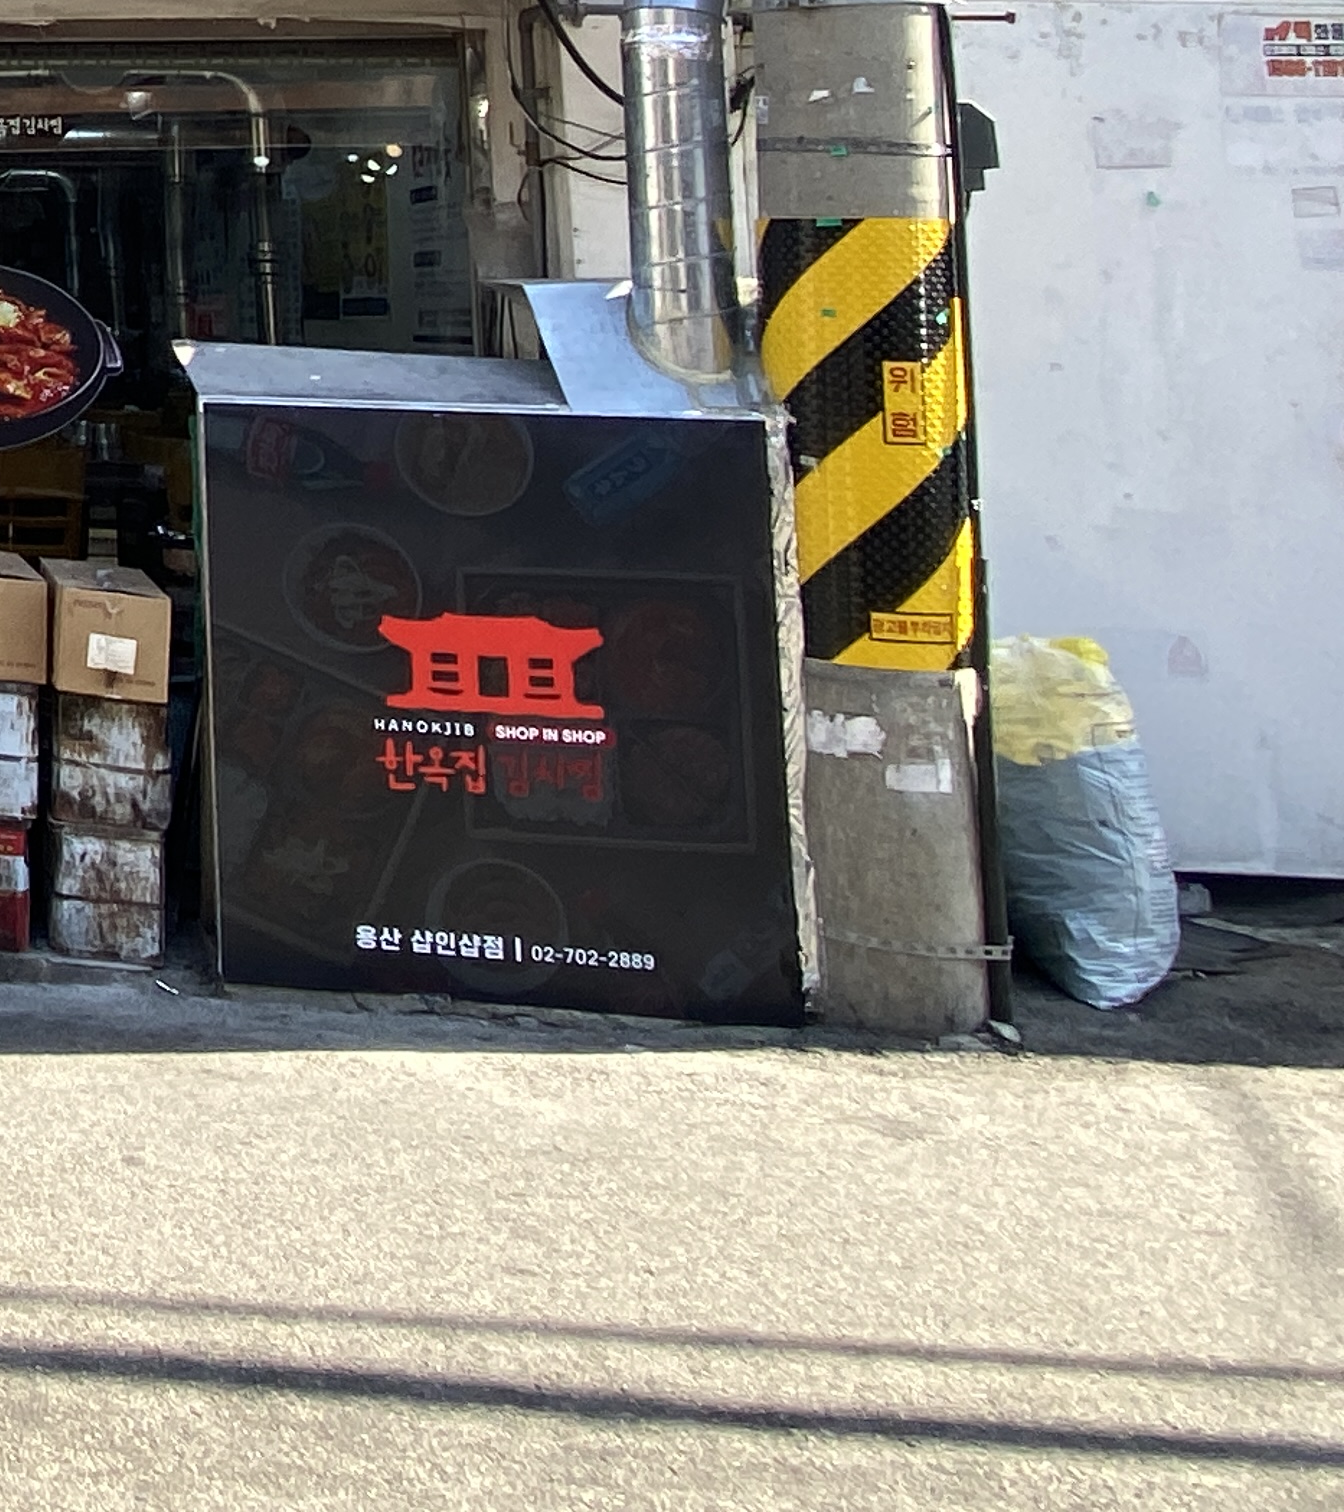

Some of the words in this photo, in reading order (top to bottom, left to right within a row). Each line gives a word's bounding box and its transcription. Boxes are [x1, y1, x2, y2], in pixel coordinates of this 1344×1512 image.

[374, 718, 475, 737] HANOKJIB
[495, 724, 539, 740] SHOP
[542, 727, 559, 742] IN
[561, 728, 606, 745] SHOP
[375, 737, 487, 795] 한옥집
[355, 923, 402, 952] 용산
[410, 928, 505, 962] 샵인샵점
[530, 944, 656, 972] 02-702-2889
